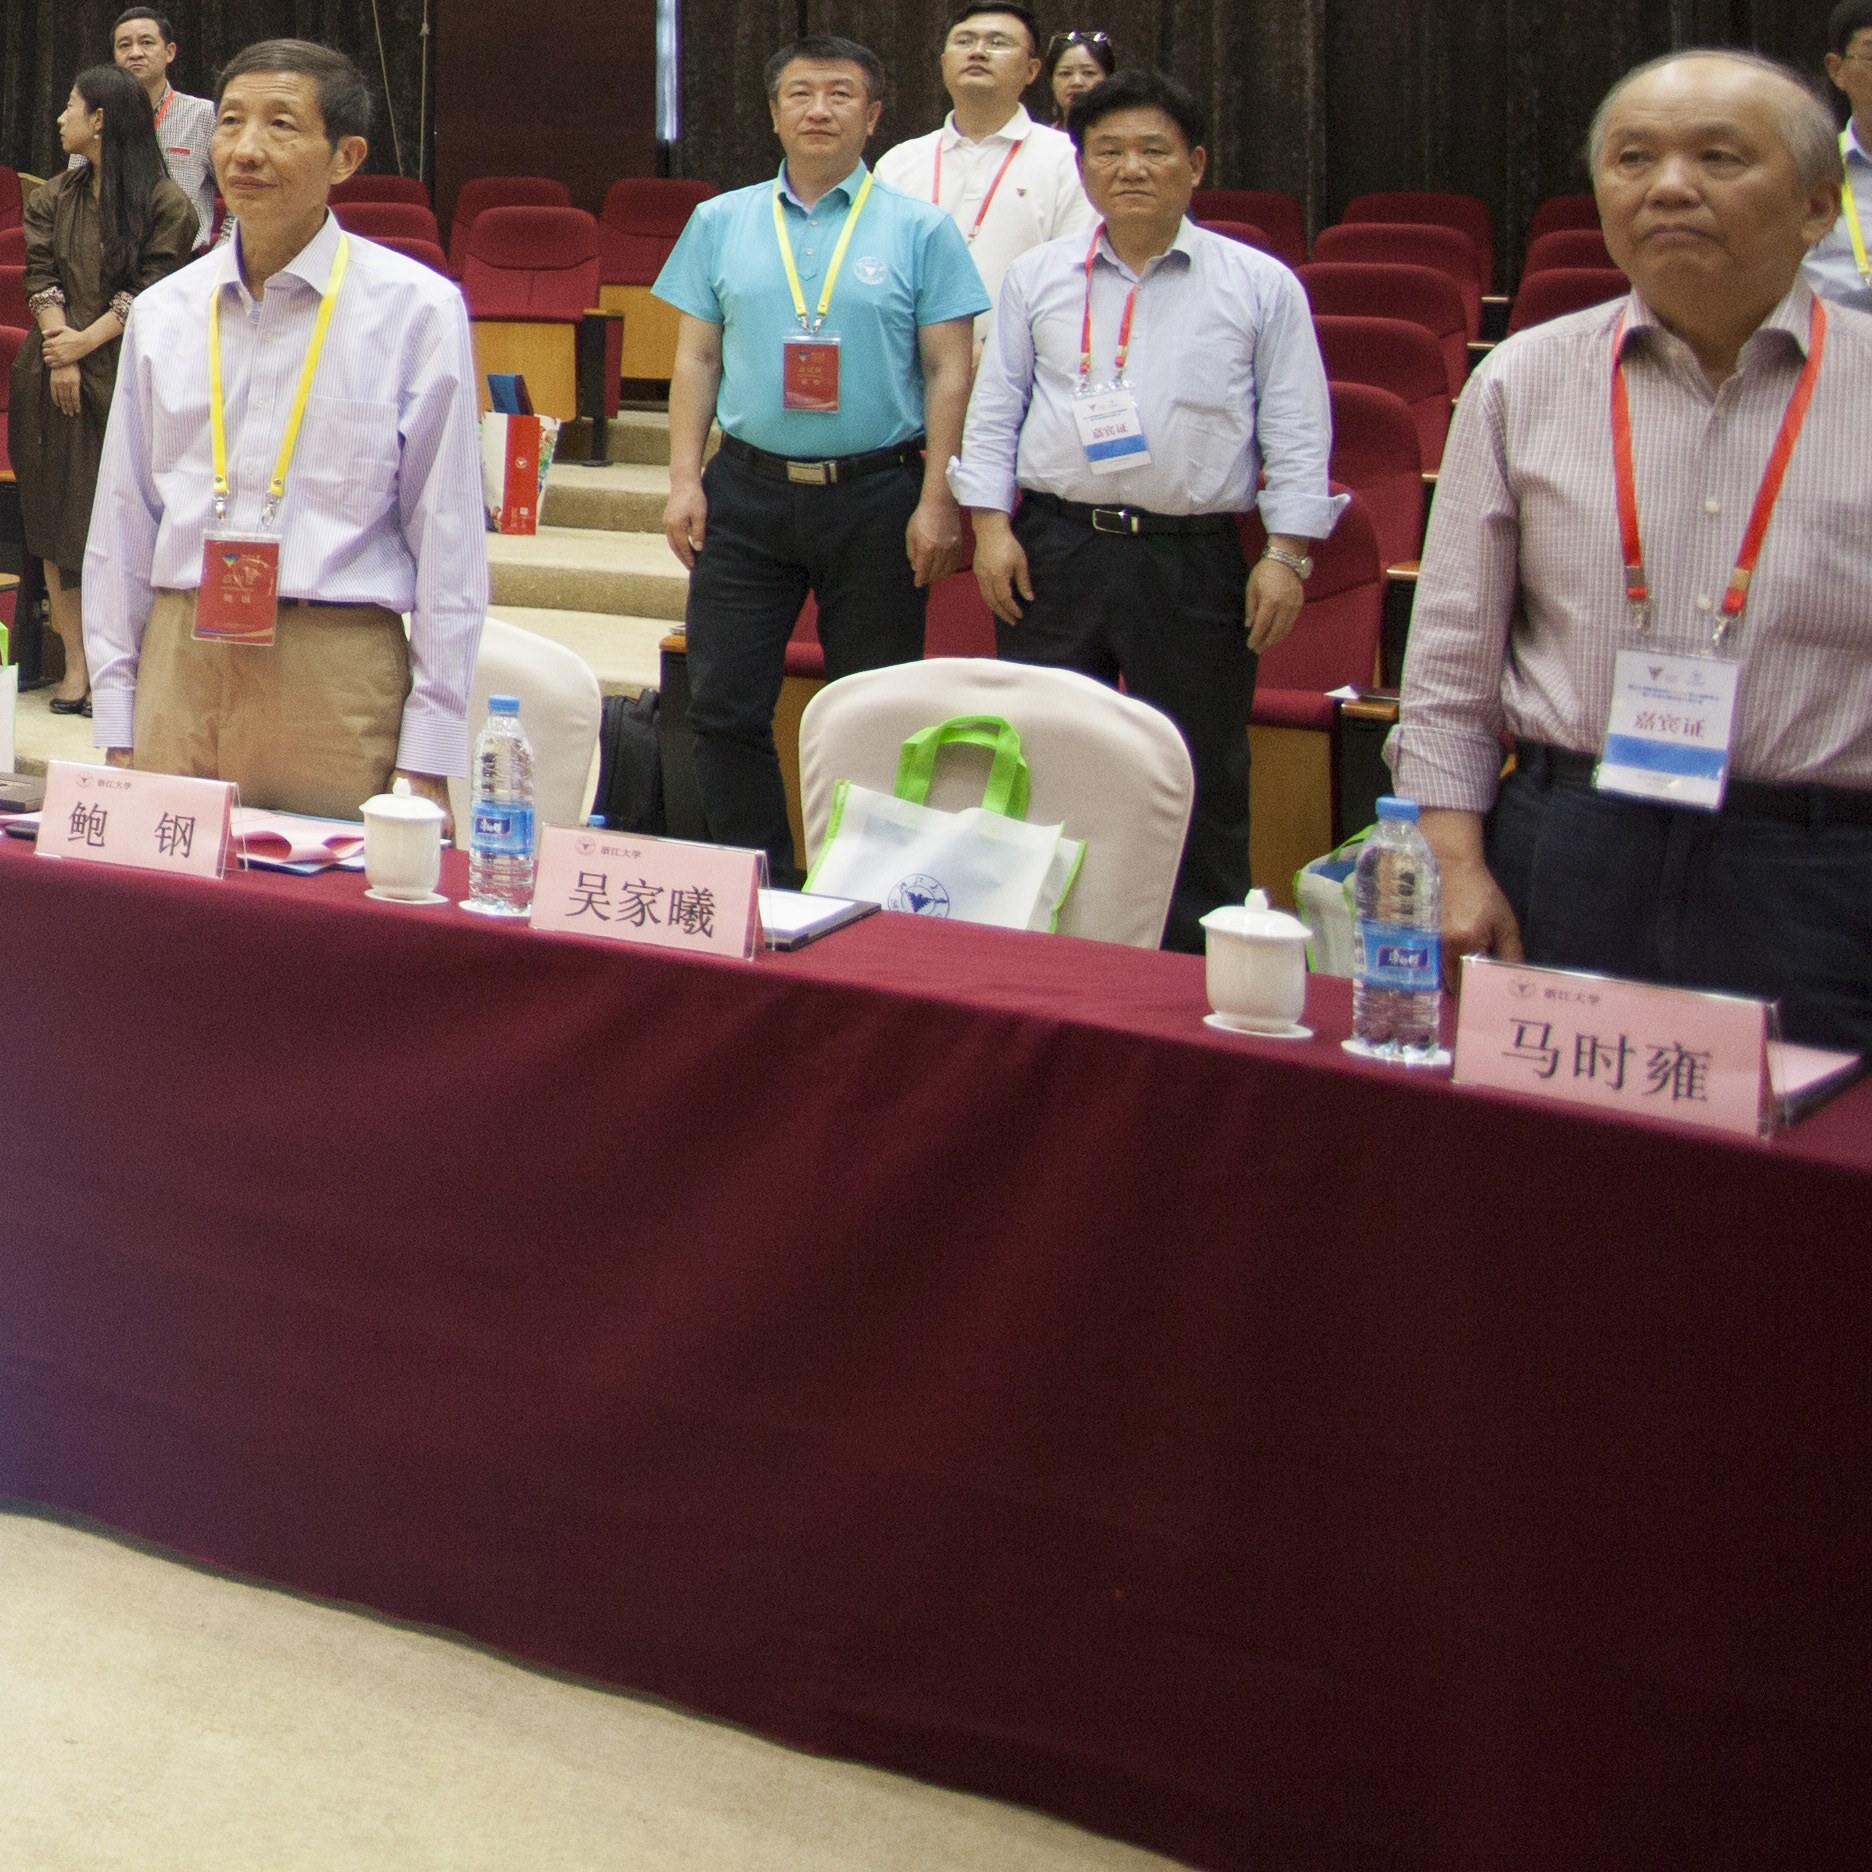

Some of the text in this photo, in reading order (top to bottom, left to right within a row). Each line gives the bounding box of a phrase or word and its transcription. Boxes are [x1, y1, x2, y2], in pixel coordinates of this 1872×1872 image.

[96, 778, 133, 792] 浙江大学
[599, 845, 643, 860] 浙江大学
[564, 869, 718, 939] 吴家曦
[1501, 1016, 1714, 1104] 马时雍
